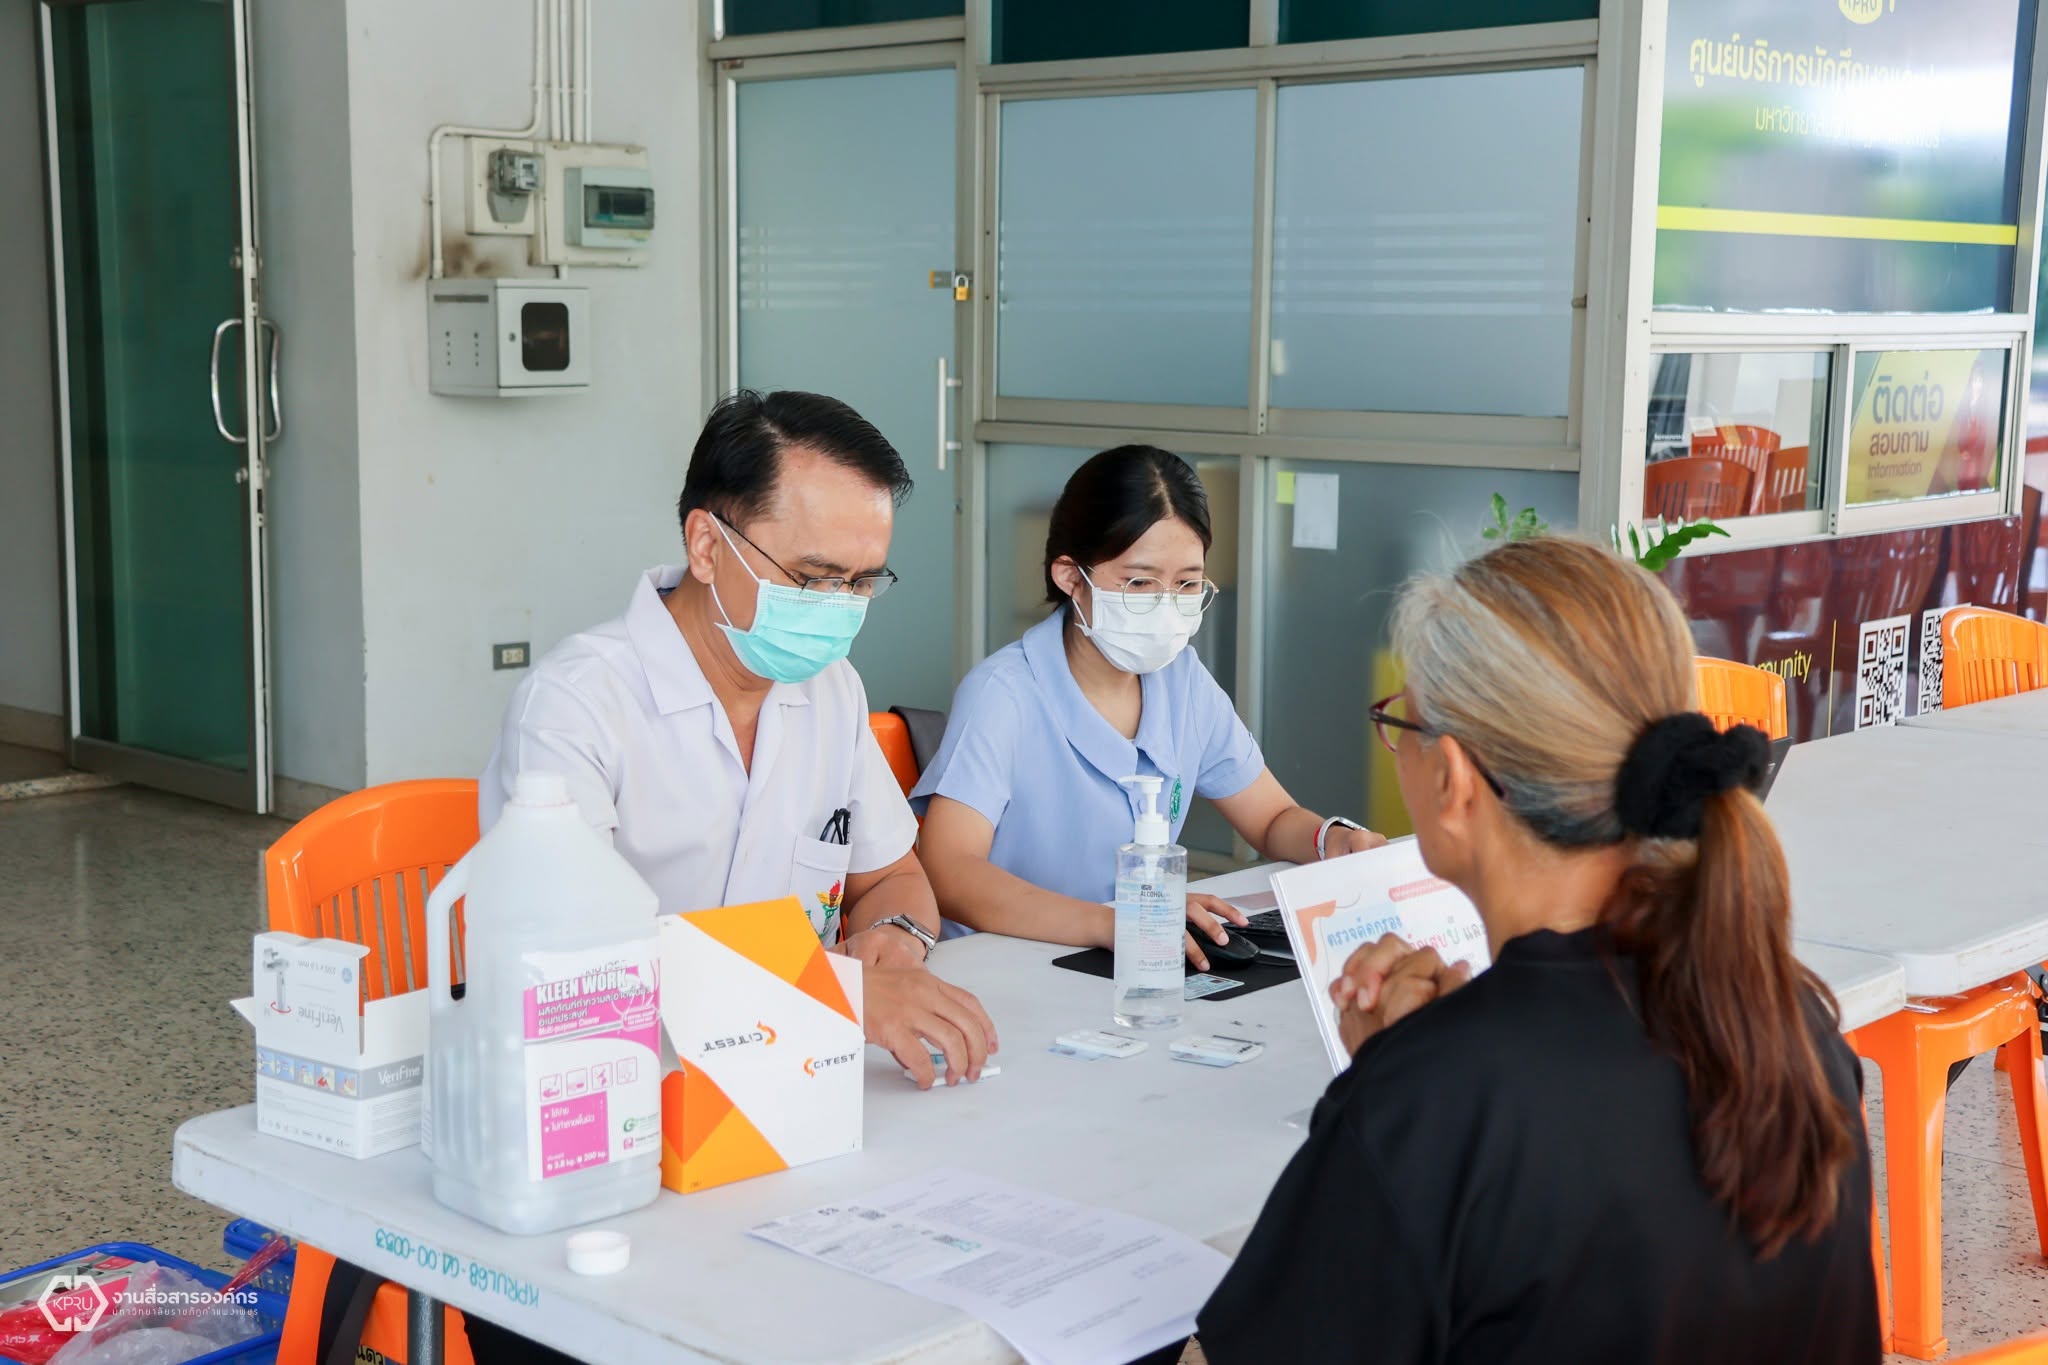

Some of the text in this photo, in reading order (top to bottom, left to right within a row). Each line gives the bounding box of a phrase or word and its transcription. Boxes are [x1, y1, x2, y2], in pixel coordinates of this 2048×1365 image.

[1872, 370, 1945, 425] ติดต่อ
[1869, 428, 1930, 457] สอบถาม
[1867, 458, 1922, 480] Information
[536, 969, 627, 1004] KLEEN WORK
